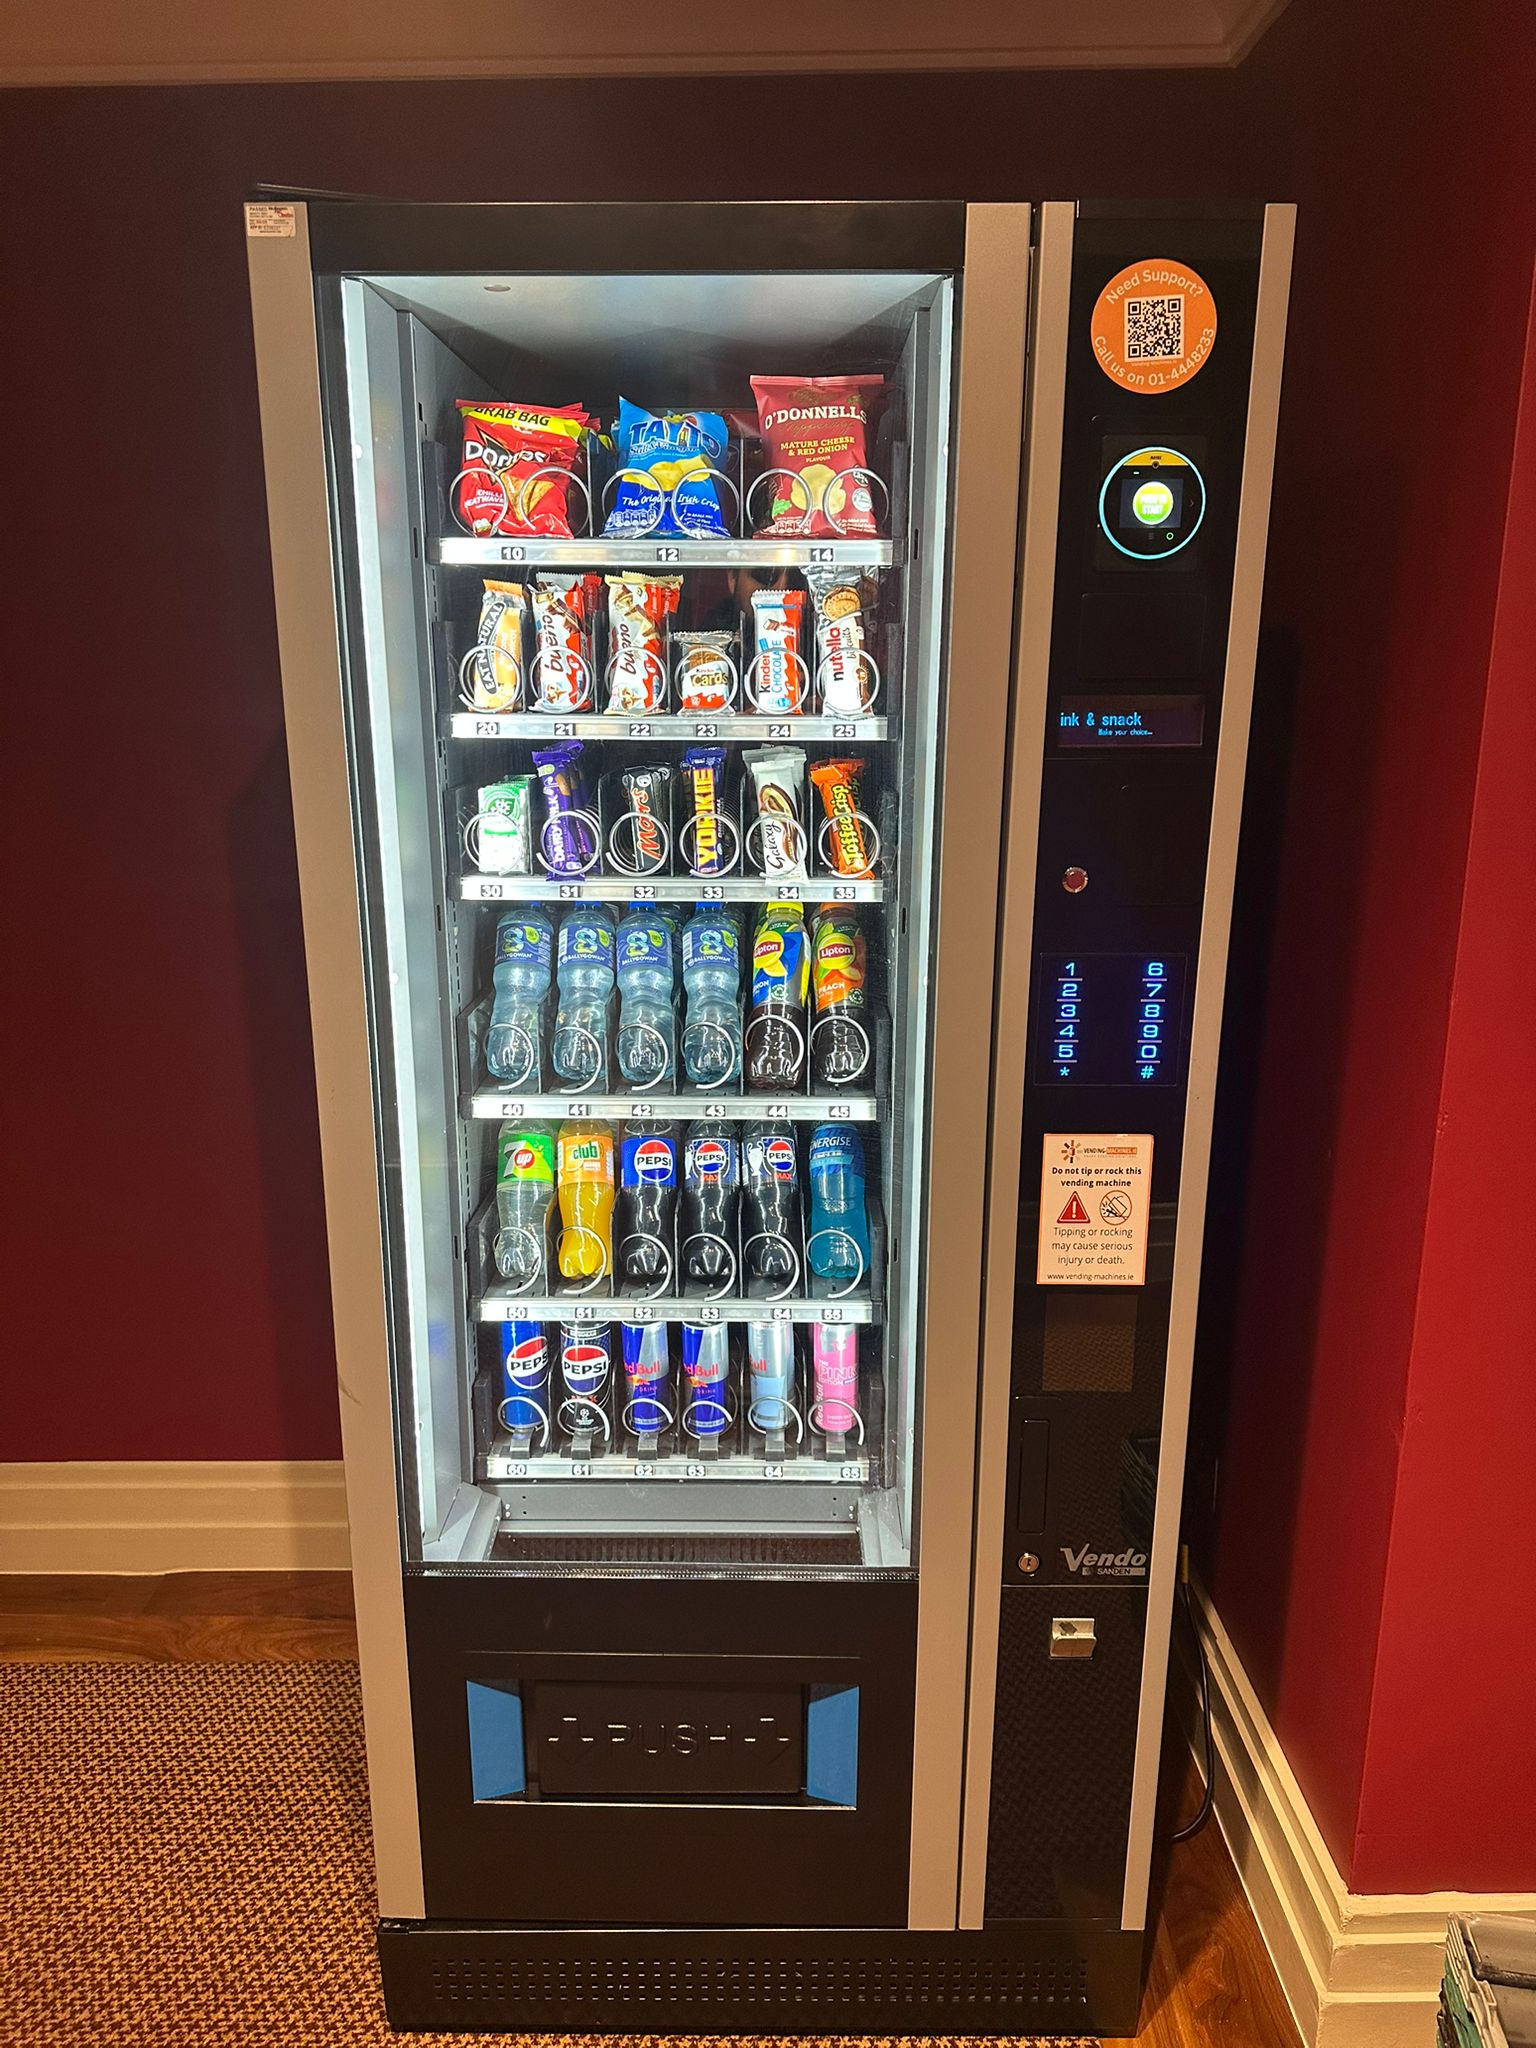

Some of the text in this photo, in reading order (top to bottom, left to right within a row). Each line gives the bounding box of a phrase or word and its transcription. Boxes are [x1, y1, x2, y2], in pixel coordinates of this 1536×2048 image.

[1105, 269, 1204, 304] Need Support?
[1095, 328, 1214, 386] Call us on 01-4448233
[518, 411, 551, 426] BAG
[765, 406, 867, 430] O'DONNELLS
[781, 436, 855, 450] MATURE CHEESE
[797, 447, 815, 455] RED
[817, 444, 848, 453] ONION
[677, 494, 700, 503] Irish
[504, 547, 523, 560] 10
[658, 548, 677, 561] 12
[812, 549, 832, 561] 14
[842, 627, 857, 659] bicuits
[771, 640, 782, 693] CHOCOLAE
[481, 666, 495, 690] EAT
[759, 655, 770, 693] Kinder
[691, 673, 728, 687] Cards
[1060, 712, 1142, 726] ink & snack
[478, 723, 497, 734] 20
[556, 724, 574, 735] 21
[630, 725, 650, 736] 22
[697, 725, 716, 736] 23
[770, 725, 789, 736] 24
[835, 725, 855, 736] 25
[631, 788, 662, 860] Mars
[766, 822, 785, 869] Galaxy
[837, 815, 863, 865] Toffee
[482, 886, 501, 897] 30
[561, 886, 578, 897] 31
[635, 887, 654, 898] 32
[704, 887, 722, 898] 33
[779, 888, 798, 898] 34
[836, 888, 854, 898] 35
[821, 946, 850, 957] Lipton
[1065, 962, 1075, 976] 1
[1147, 962, 1164, 976] 6
[819, 982, 845, 993] PEACH
[1062, 983, 1078, 997] 2
[1146, 983, 1162, 997] 7
[1060, 1004, 1076, 1018] 3
[1144, 1004, 1160, 1018] 8
[1059, 1024, 1075, 1038] 4
[1143, 1025, 1158, 1038] 9
[1058, 1044, 1074, 1058] 5
[1141, 1045, 1157, 1058] 0
[1140, 1065, 1155, 1079] #
[503, 1105, 522, 1115] 40
[569, 1105, 588, 1115] 41
[633, 1105, 652, 1116] 42
[706, 1105, 725, 1116] 43
[769, 1106, 787, 1116] 44
[830, 1106, 849, 1117] 45
[573, 1140, 598, 1159] club
[637, 1157, 671, 1167] PEPSI
[697, 1154, 725, 1162] PEPSI
[1052, 1167, 1063, 1175] Do
[1081, 1167, 1092, 1177] tip
[1105, 1167, 1124, 1175] rock
[1126, 1167, 1142, 1175] this
[1061, 1179, 1132, 1188] vending machine
[1053, 1227, 1086, 1238] Tipping
[1100, 1228, 1133, 1239] rocking
[1052, 1243, 1071, 1252] may
[1101, 1242, 1133, 1250] serious
[1058, 1256, 1083, 1266] injury
[1097, 1256, 1125, 1264] death.
[1047, 1273, 1134, 1281] www.vending-machines.ie
[577, 1308, 592, 1318] 51
[635, 1308, 652, 1318] 52
[702, 1308, 719, 1319] 53
[773, 1309, 791, 1319] 54
[824, 1309, 841, 1319] 55
[511, 1352, 547, 1370] PEPS
[564, 1361, 607, 1374] PEPSI
[637, 1360, 660, 1374] Bull
[695, 1364, 718, 1377] Bull
[507, 1466, 525, 1475] 60
[573, 1465, 590, 1475] 61
[636, 1466, 653, 1476] 62
[688, 1466, 705, 1476] 63
[765, 1467, 783, 1477] 64
[842, 1467, 860, 1477] 65
[1060, 1544, 1147, 1572] Vendo
[607, 1724, 731, 1754] PUSH
